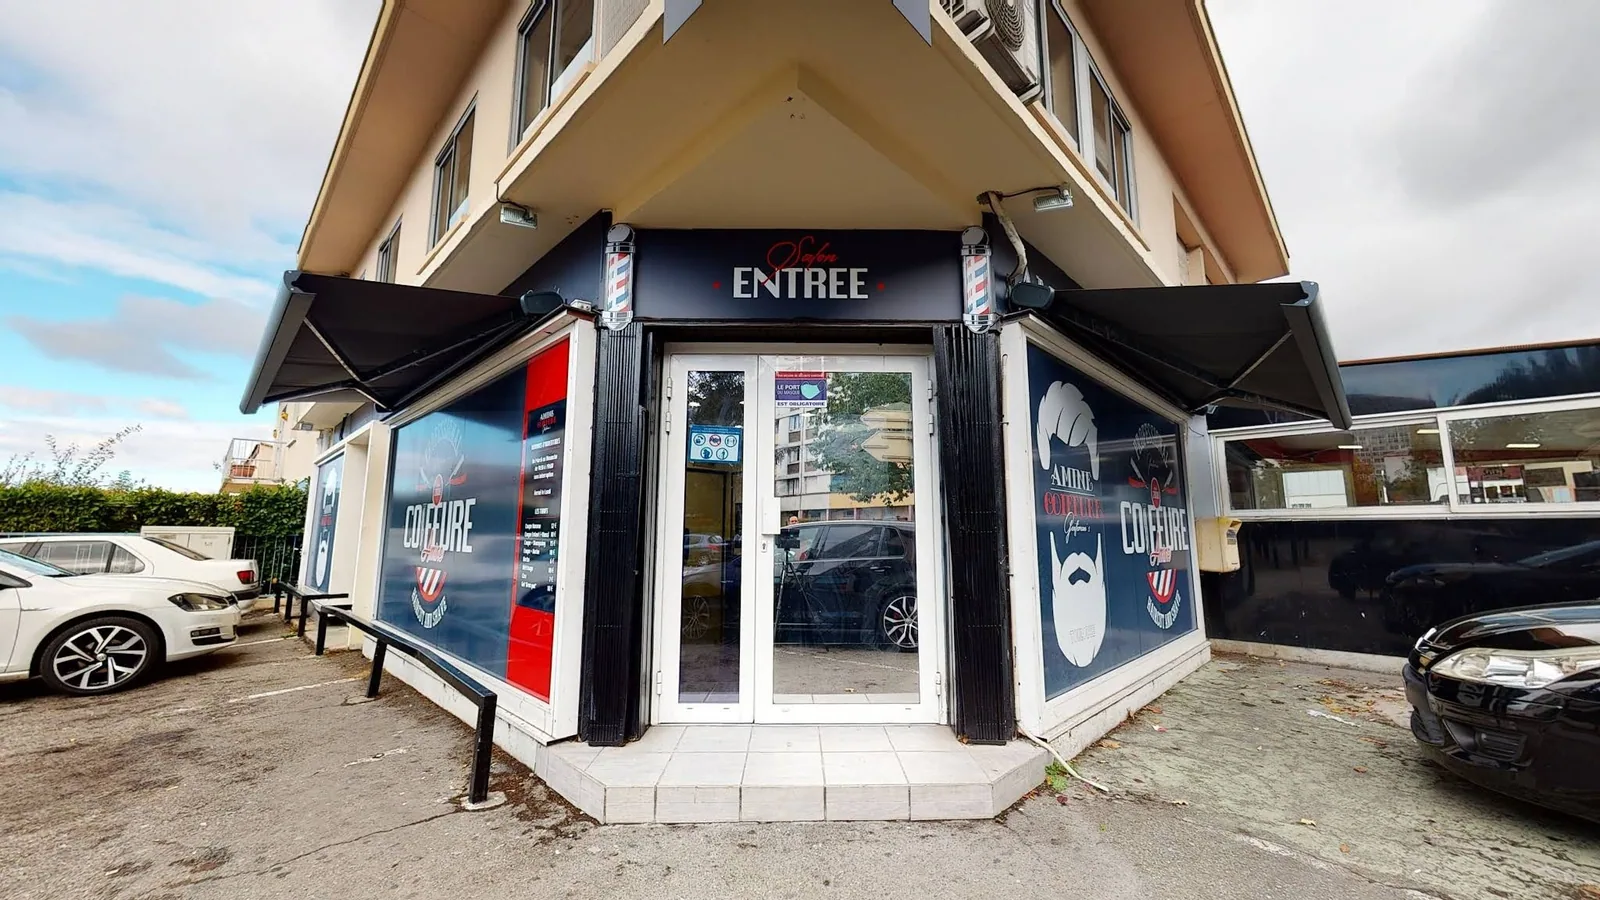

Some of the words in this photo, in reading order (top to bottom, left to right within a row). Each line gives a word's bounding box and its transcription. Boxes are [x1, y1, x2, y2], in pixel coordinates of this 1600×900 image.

[761, 236, 838, 285] Salon
[733, 267, 868, 299] ENTREE
[1051, 463, 1094, 491] AMINE
